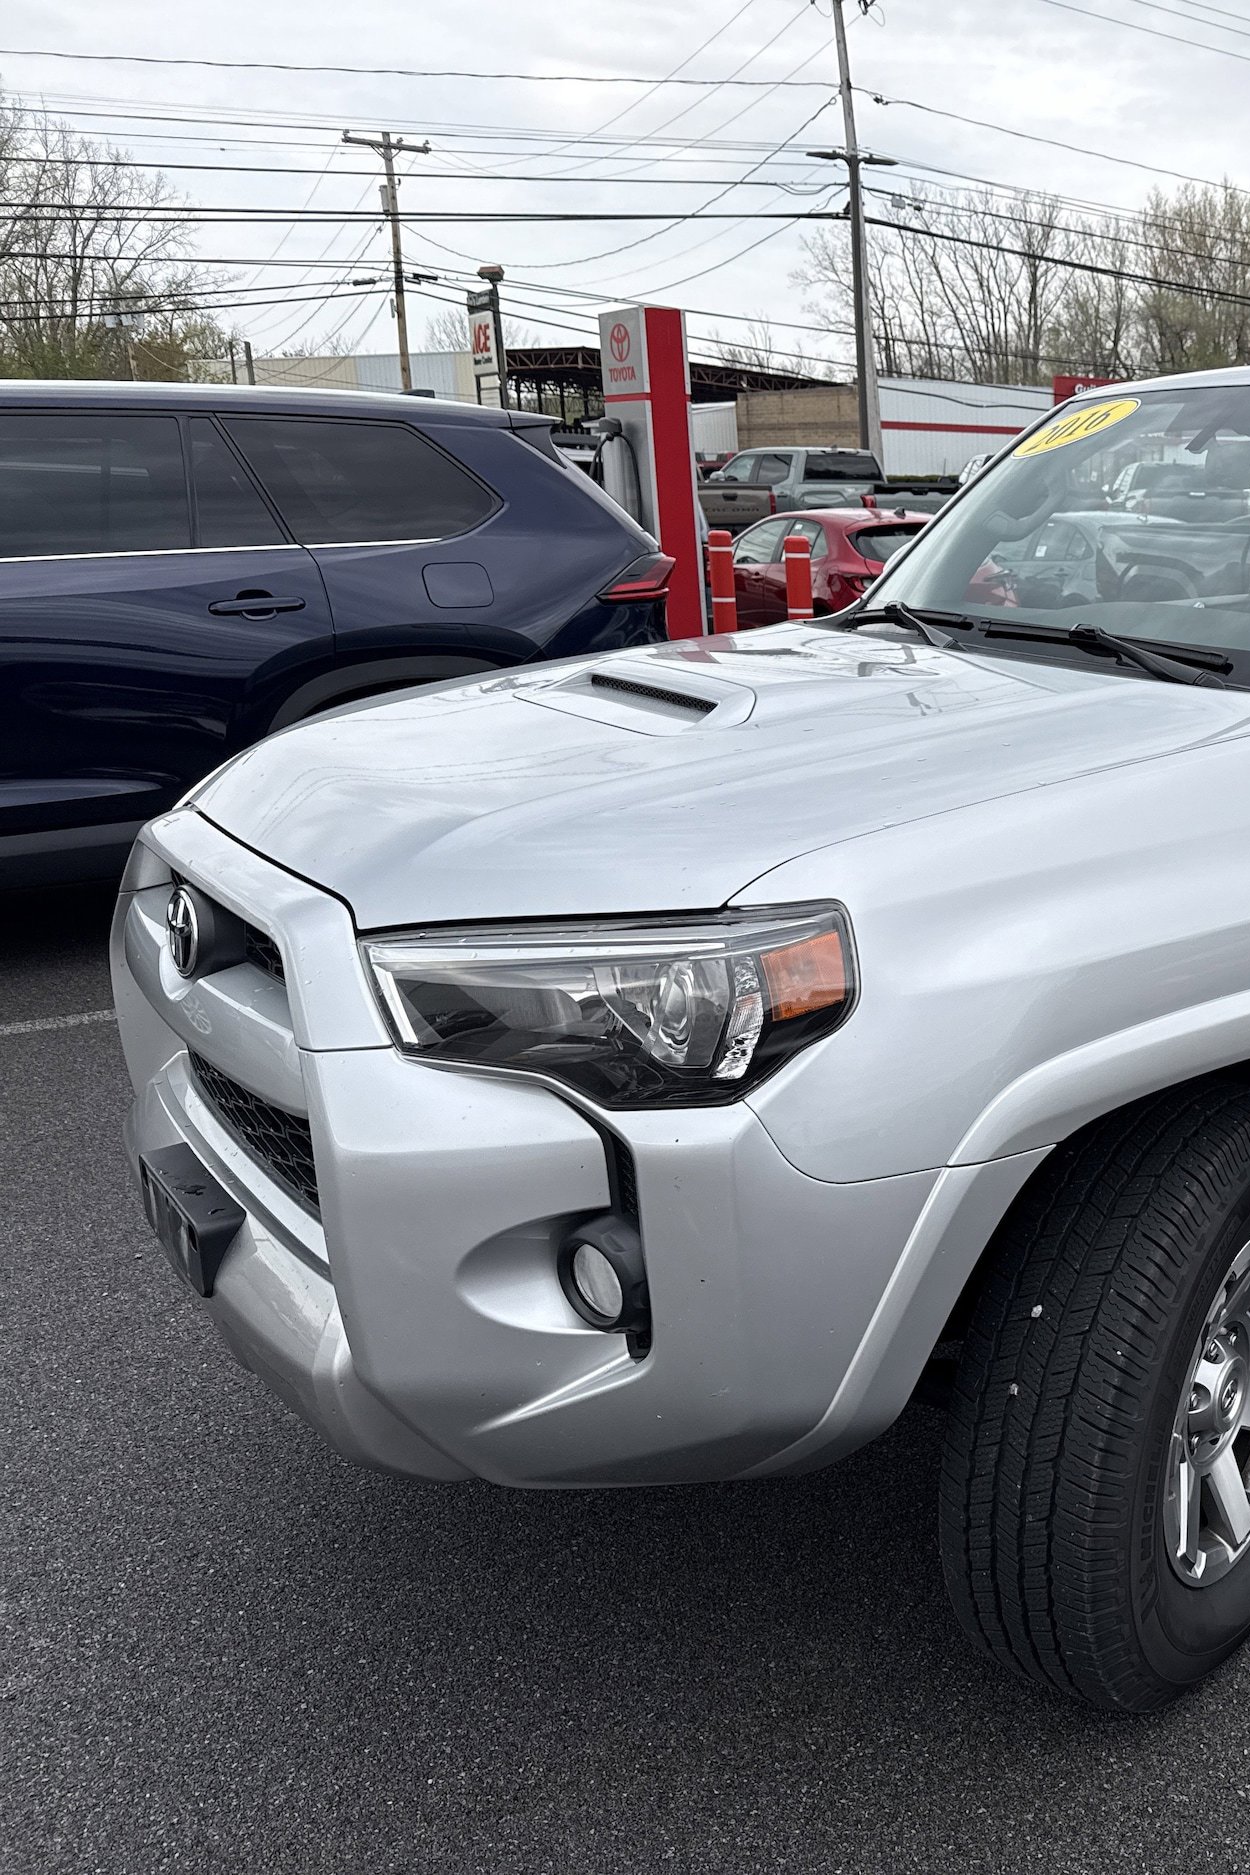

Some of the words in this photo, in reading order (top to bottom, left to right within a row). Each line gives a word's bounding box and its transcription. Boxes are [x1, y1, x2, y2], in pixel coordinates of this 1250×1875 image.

[472, 324, 490, 355] ACE
[608, 366, 637, 383] TOYOTA
[1023, 402, 1125, 453] 2016
